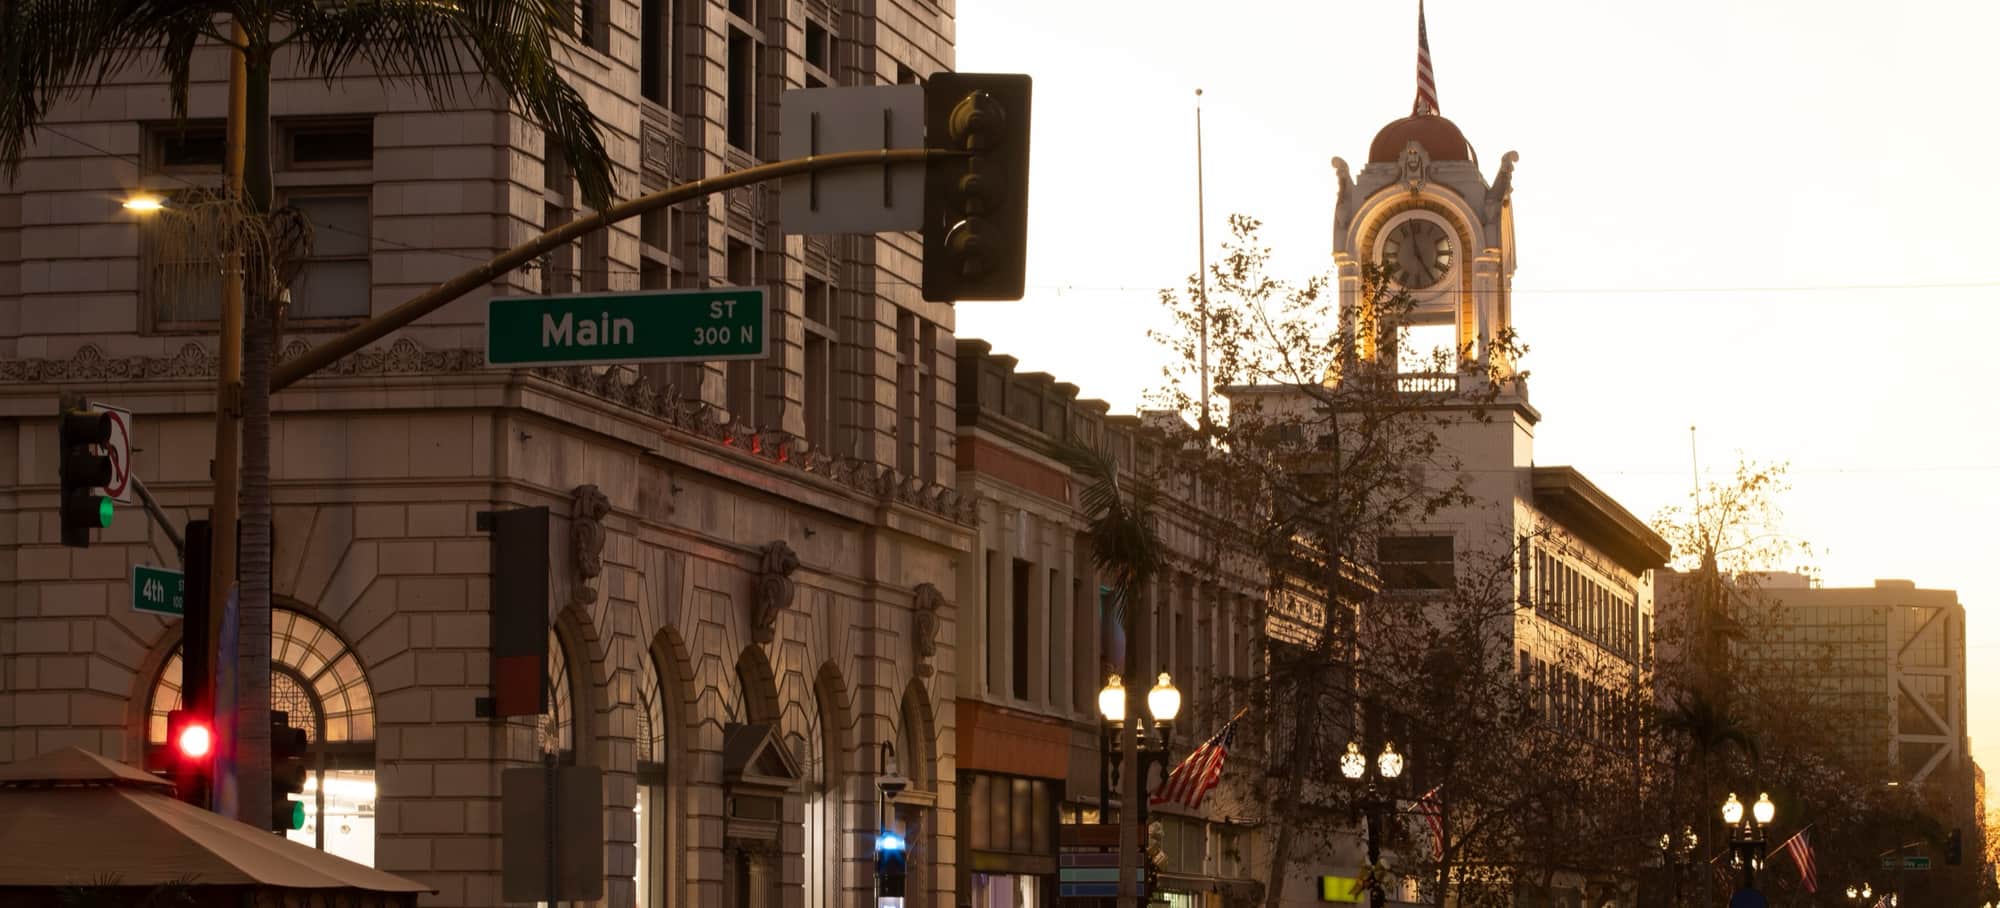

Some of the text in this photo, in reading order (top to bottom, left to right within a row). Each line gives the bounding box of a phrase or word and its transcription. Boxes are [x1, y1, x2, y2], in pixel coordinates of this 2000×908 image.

[709, 300, 737, 319] ST
[541, 311, 635, 348] Main
[692, 325, 753, 346] 300 N
[143, 577, 164, 604] 4th
